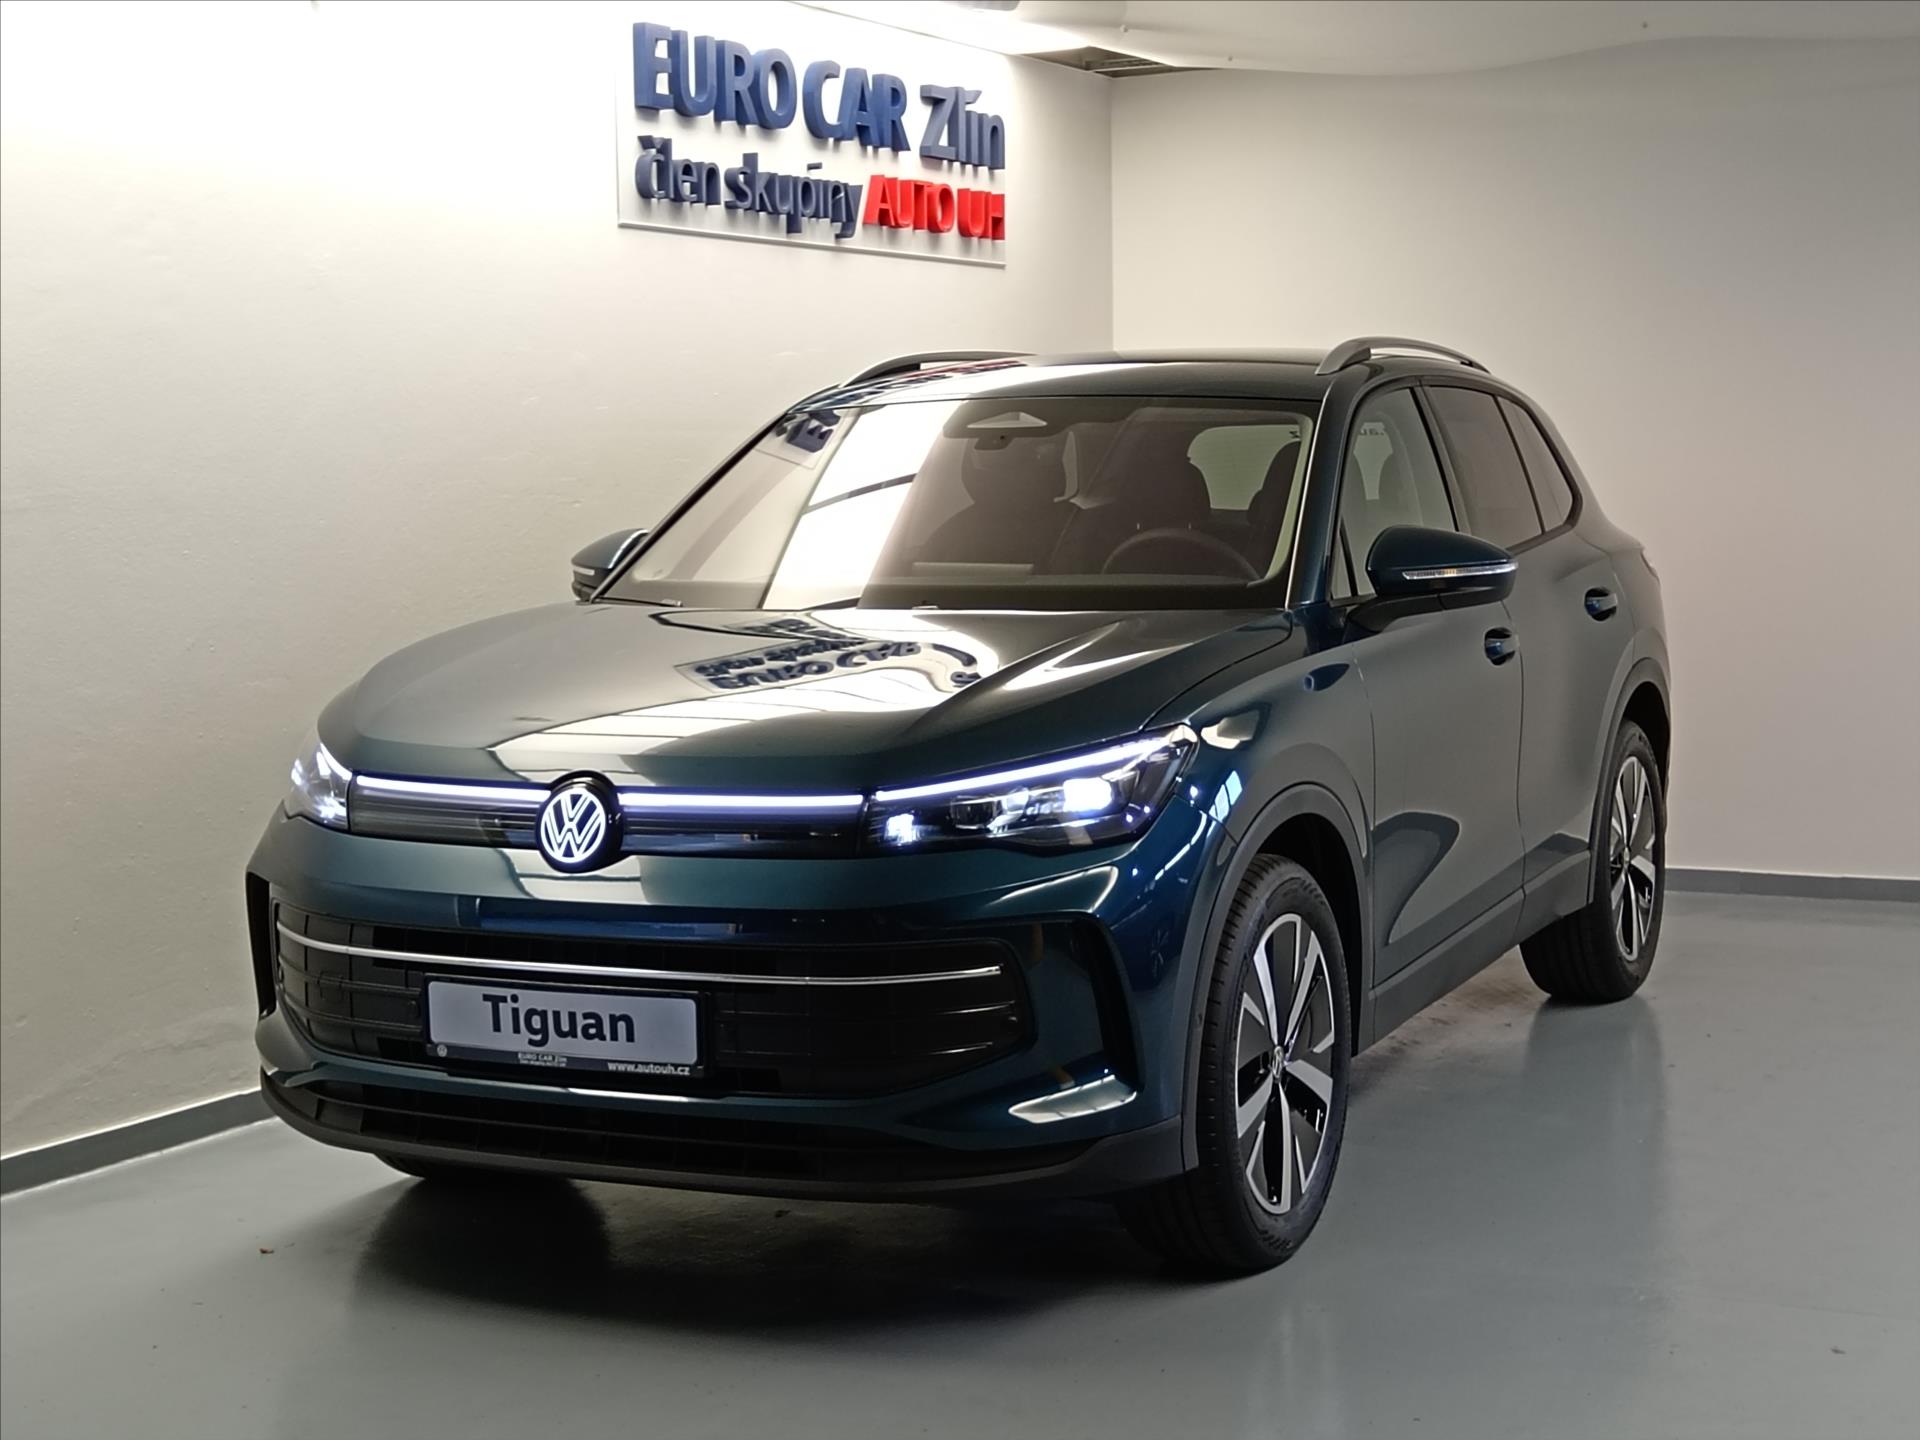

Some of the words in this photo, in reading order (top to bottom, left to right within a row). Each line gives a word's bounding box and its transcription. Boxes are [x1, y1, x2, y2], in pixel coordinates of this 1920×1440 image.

[633, 22, 797, 129] EURO
[803, 60, 911, 152] CAR
[920, 84, 1005, 170] Zlín
[635, 135, 721, 206] člen
[724, 152, 863, 239] skupiny
[862, 174, 956, 233] AUTO
[957, 188, 1005, 240] UH
[541, 787, 606, 863] VW
[482, 994, 636, 1048] Tiguan
[607, 1062, 690, 1075] www.autouh.cz
